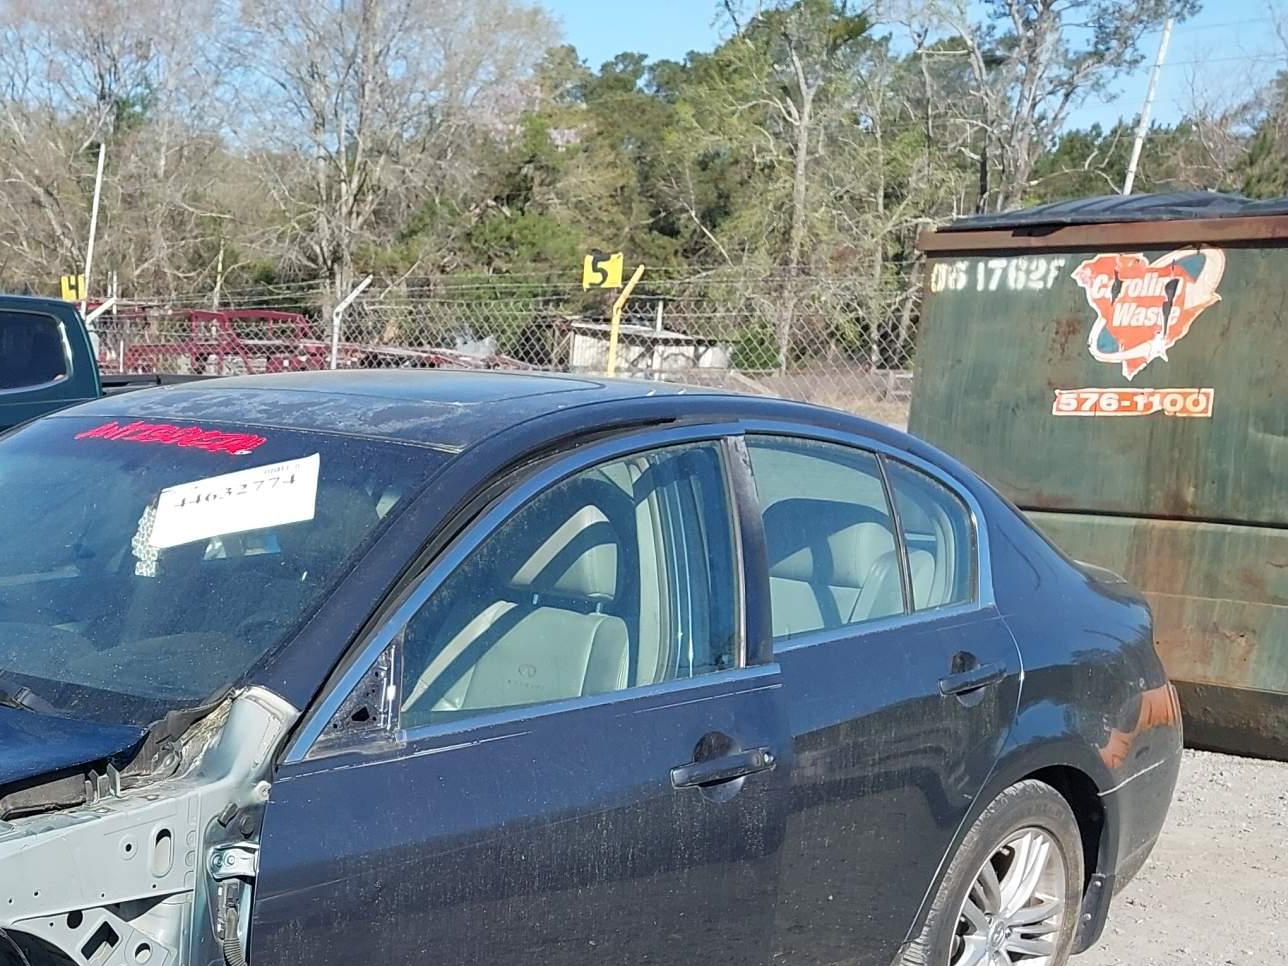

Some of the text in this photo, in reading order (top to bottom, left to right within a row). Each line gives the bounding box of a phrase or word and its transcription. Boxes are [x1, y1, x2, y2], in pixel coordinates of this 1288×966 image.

[589, 248, 611, 287] 5
[68, 274, 79, 300] 4
[1092, 273, 1184, 299] Crolin
[1058, 393, 1207, 412] 576-1100
